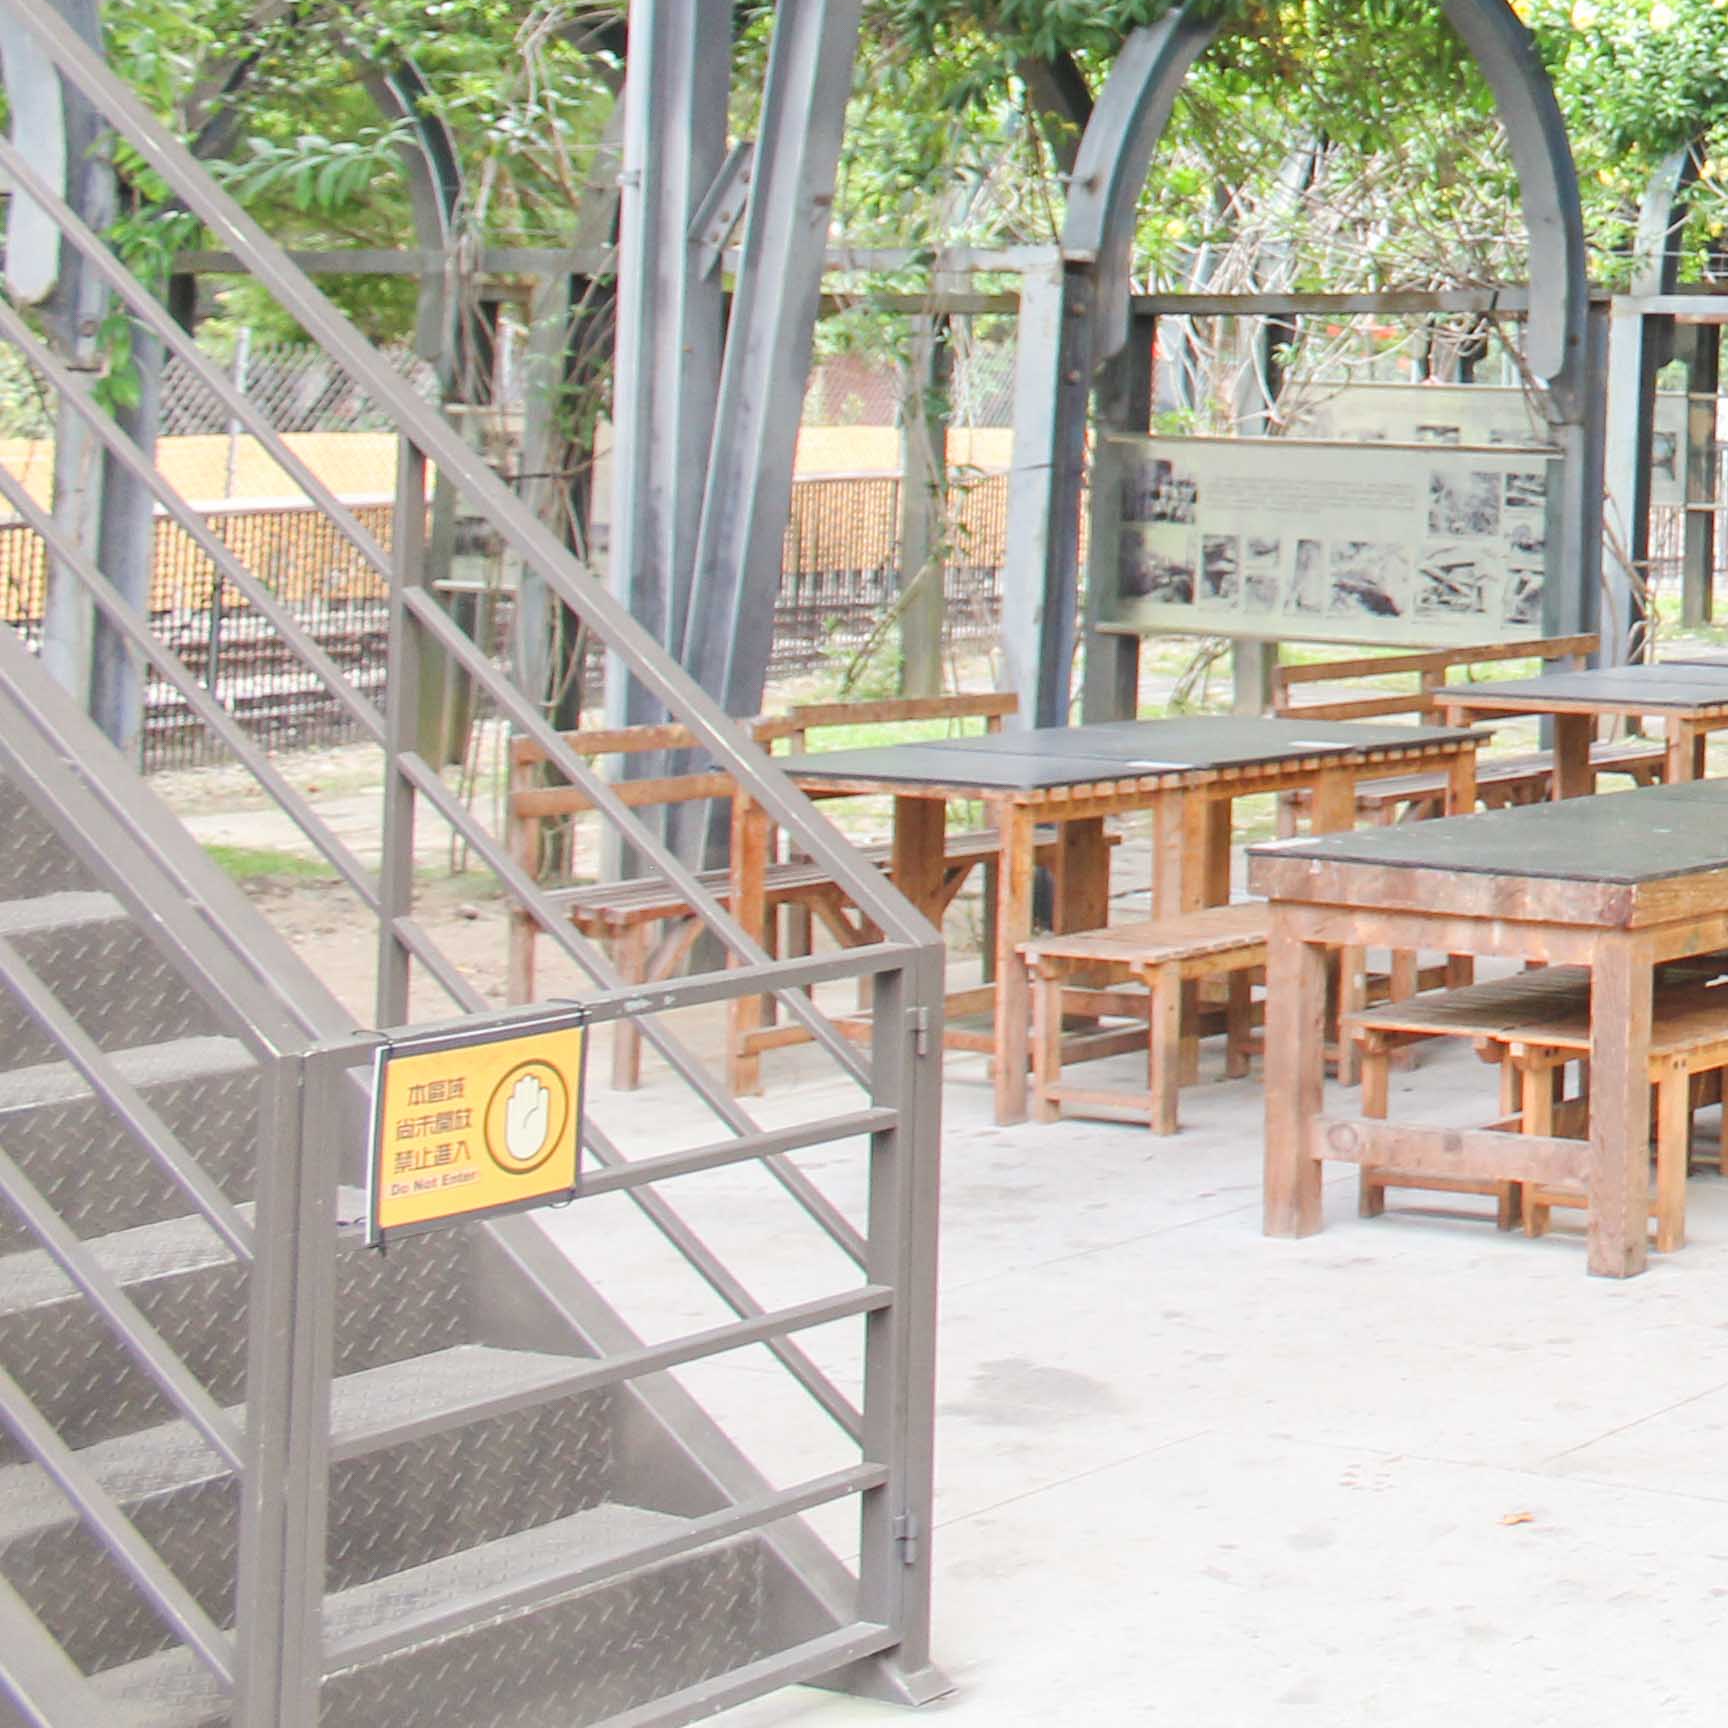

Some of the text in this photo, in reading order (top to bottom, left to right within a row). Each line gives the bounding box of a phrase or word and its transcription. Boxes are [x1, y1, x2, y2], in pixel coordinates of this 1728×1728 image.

[408, 1076, 466, 1106] 本區域
[395, 1107, 473, 1141] 尚未開放
[394, 1140, 472, 1175] 禁止進入
[391, 1170, 477, 1196] Do Not Enter
